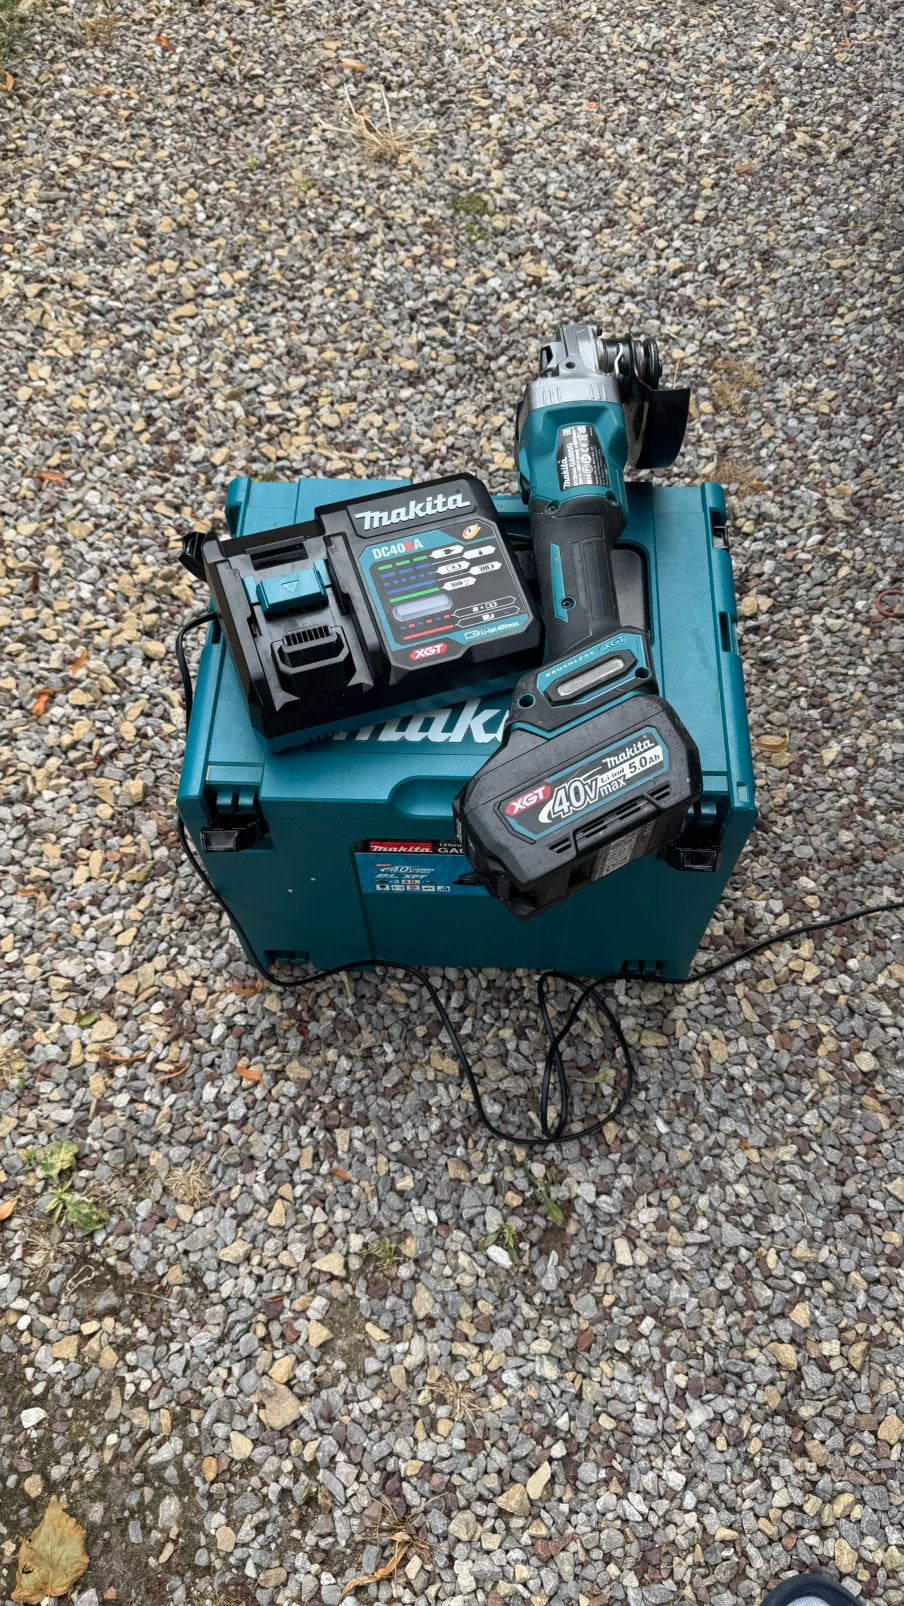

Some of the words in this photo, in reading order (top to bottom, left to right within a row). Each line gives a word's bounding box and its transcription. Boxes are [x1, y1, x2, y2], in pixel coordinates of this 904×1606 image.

[415, 643, 444, 659] XGT
[545, 651, 595, 678] BRUSHLESS
[600, 776, 627, 797] max
[510, 786, 547, 814] XGT
